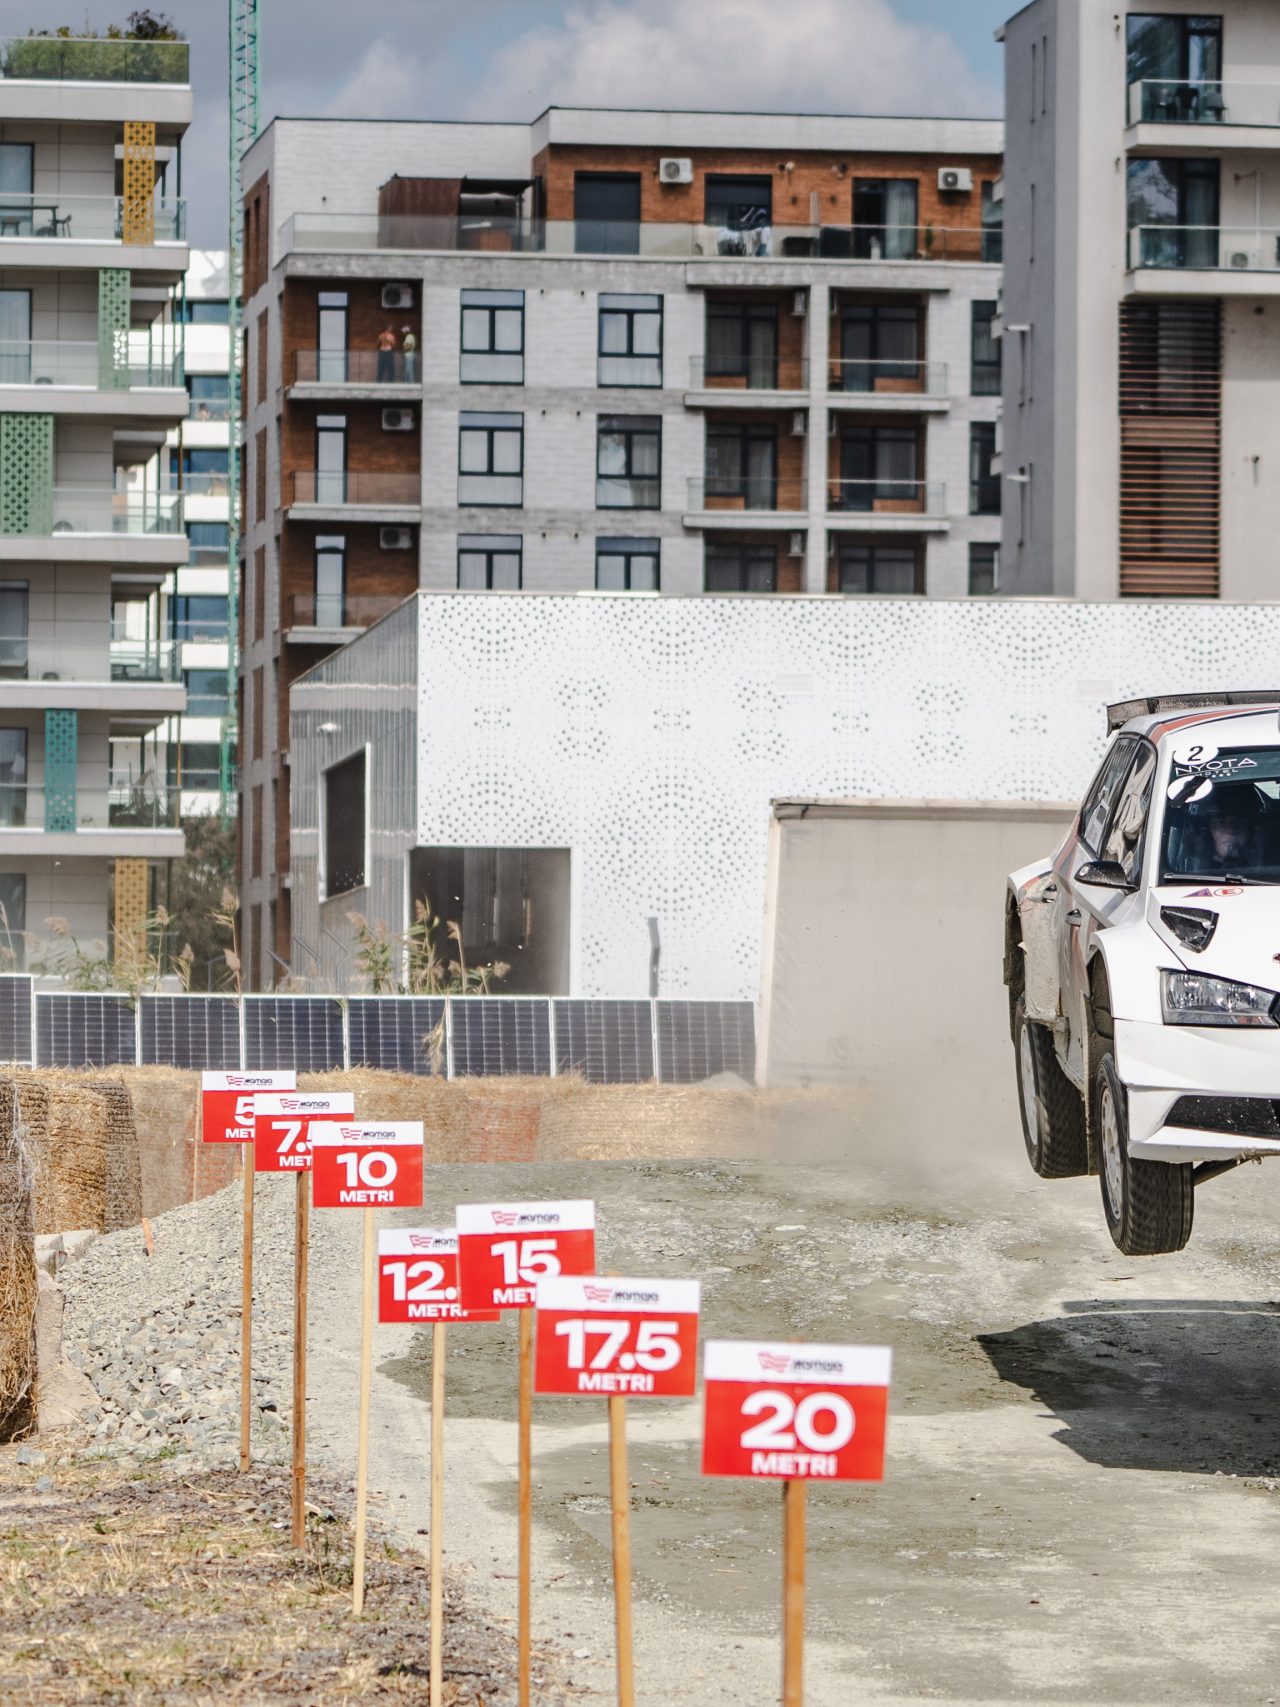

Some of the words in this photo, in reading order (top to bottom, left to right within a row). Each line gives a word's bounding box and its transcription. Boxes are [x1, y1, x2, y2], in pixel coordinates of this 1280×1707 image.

[1187, 746, 1203, 761] 2
[1175, 758, 1257, 776] NYOTA
[234, 1096, 255, 1126] 5
[225, 1128, 255, 1138] MET
[279, 1156, 312, 1167] MET
[336, 1151, 398, 1188] 10
[339, 1190, 394, 1203] METRI
[491, 1238, 561, 1285] 15
[383, 1260, 458, 1301] 12.
[492, 1287, 537, 1304] MET
[408, 1304, 469, 1318] METR
[555, 1318, 682, 1372] 17.5
[578, 1372, 654, 1392] METRI
[740, 1389, 856, 1452] 20
[751, 1452, 837, 1476] METRI
